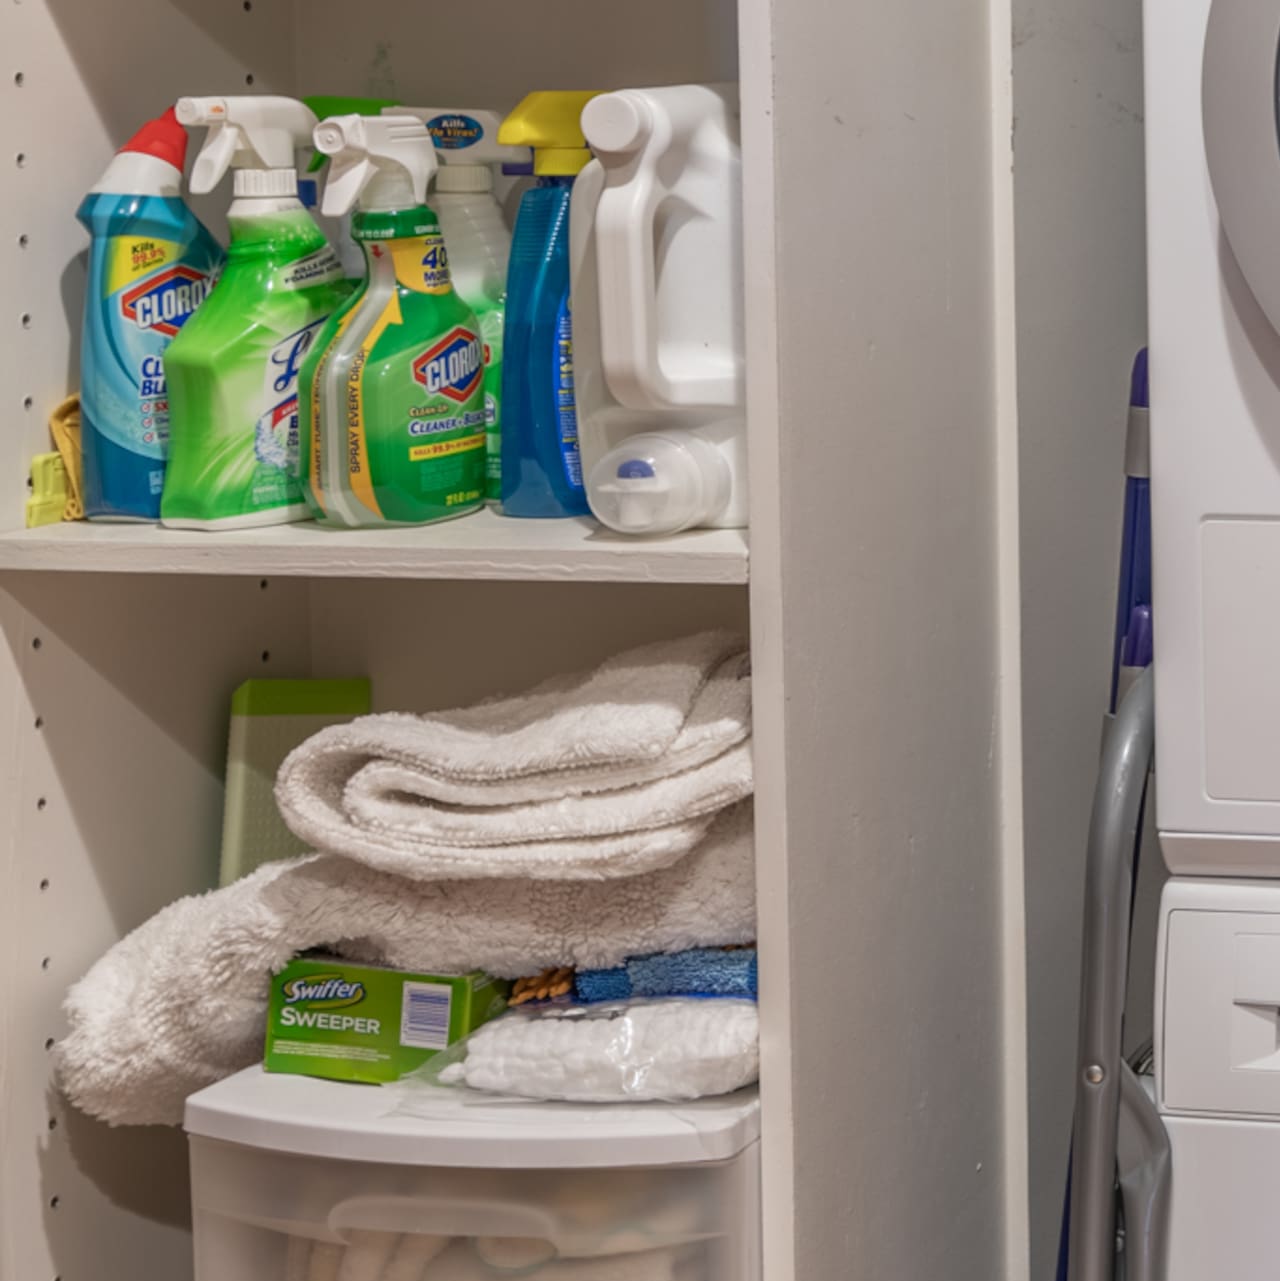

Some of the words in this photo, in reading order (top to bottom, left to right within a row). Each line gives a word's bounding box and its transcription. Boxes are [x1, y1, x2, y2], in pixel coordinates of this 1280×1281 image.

[132, 241, 155, 254] Kills
[348, 384, 360, 428] EVERY
[349, 431, 362, 474] SPRAY
[285, 978, 361, 1004] Swiffer
[280, 1007, 381, 1035] SWEEPER
